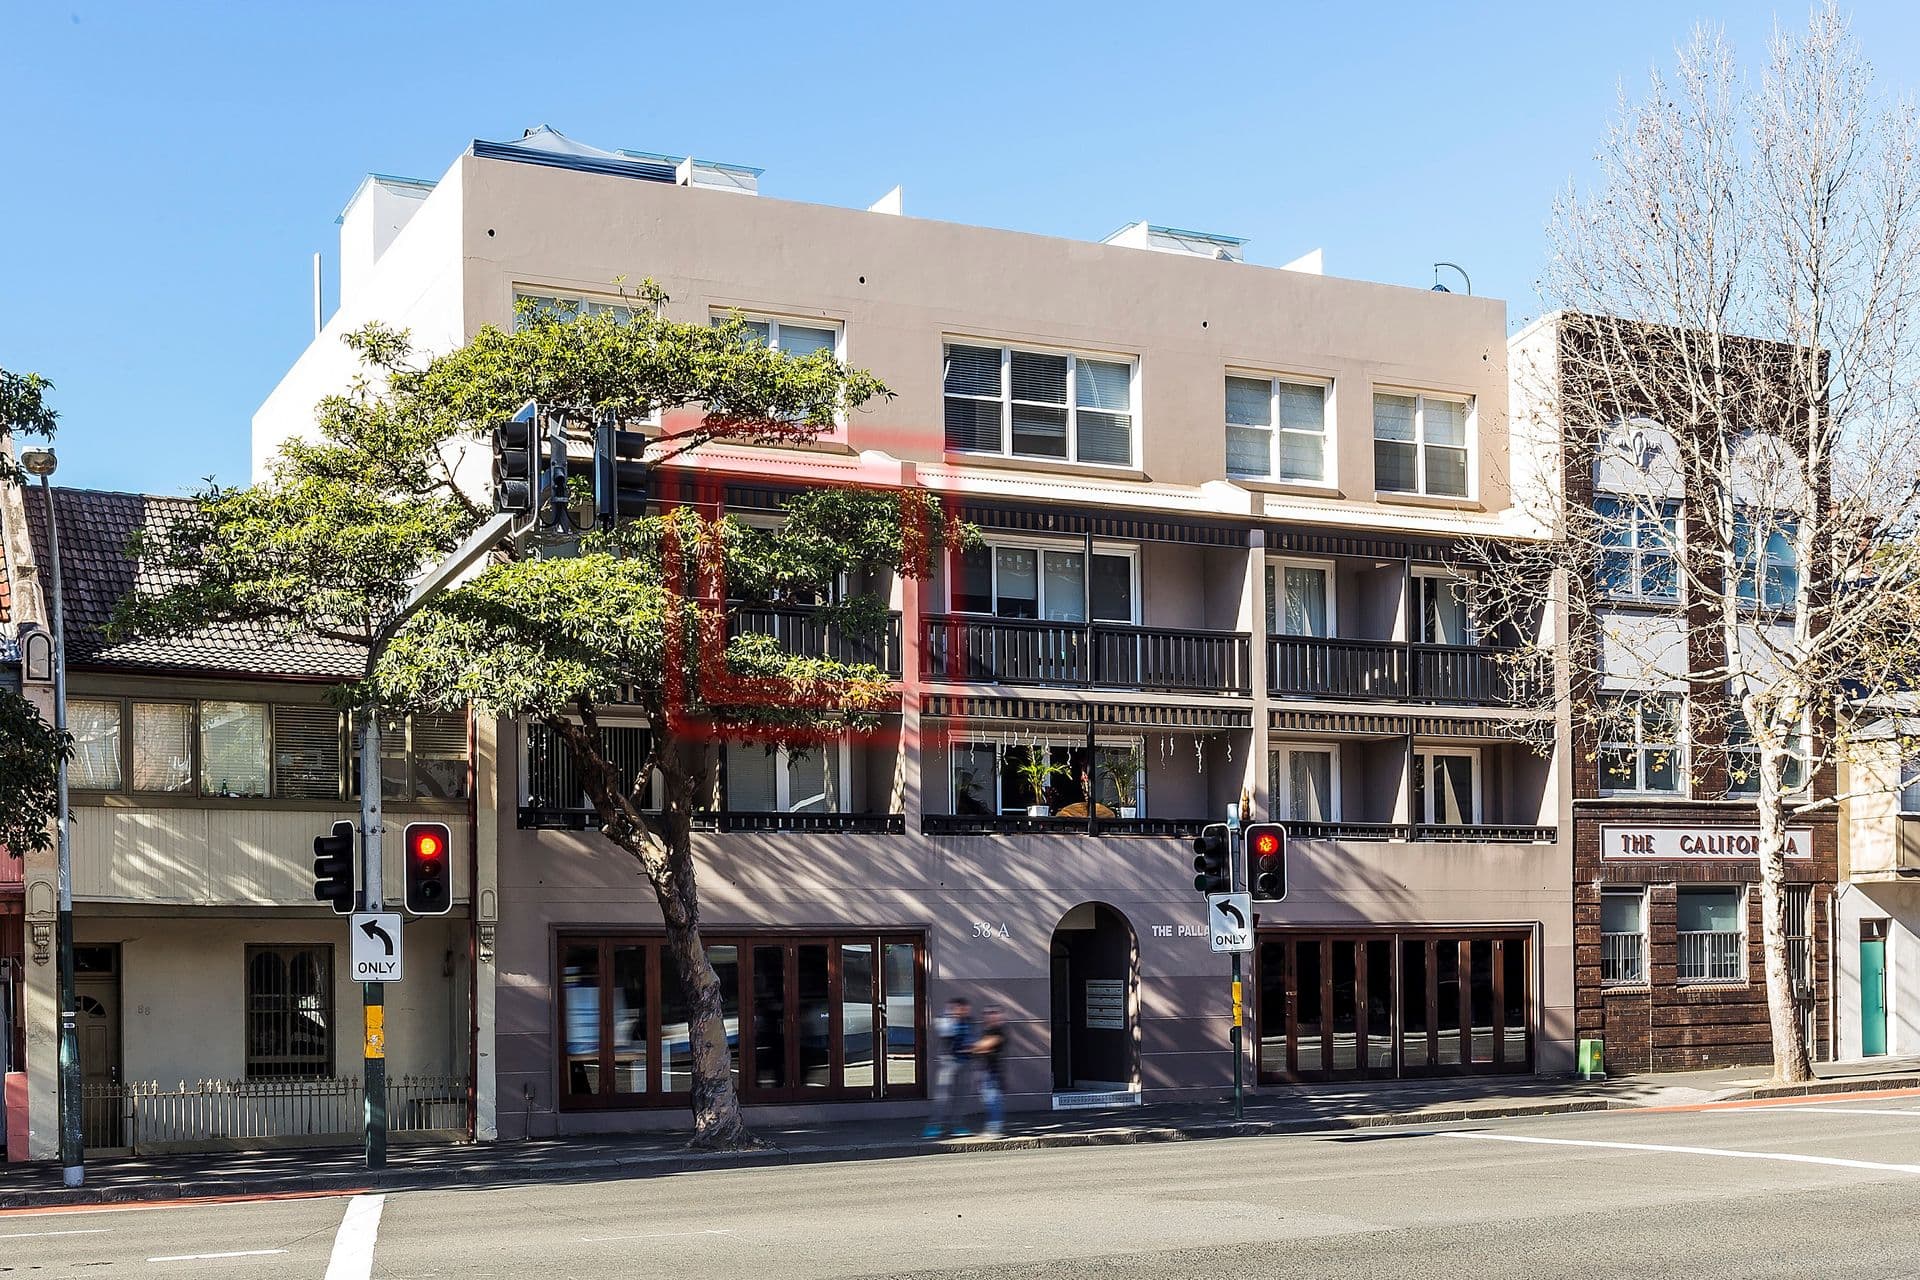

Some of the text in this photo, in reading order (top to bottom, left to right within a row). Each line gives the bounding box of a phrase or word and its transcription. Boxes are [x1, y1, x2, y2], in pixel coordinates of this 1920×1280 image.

[1621, 834, 1799, 855] THE CALIFORA
[972, 922, 1011, 938] 58 A
[1151, 925, 1173, 937] THE
[1216, 934, 1247, 946] ONLY
[358, 961, 396, 974] ONLY
